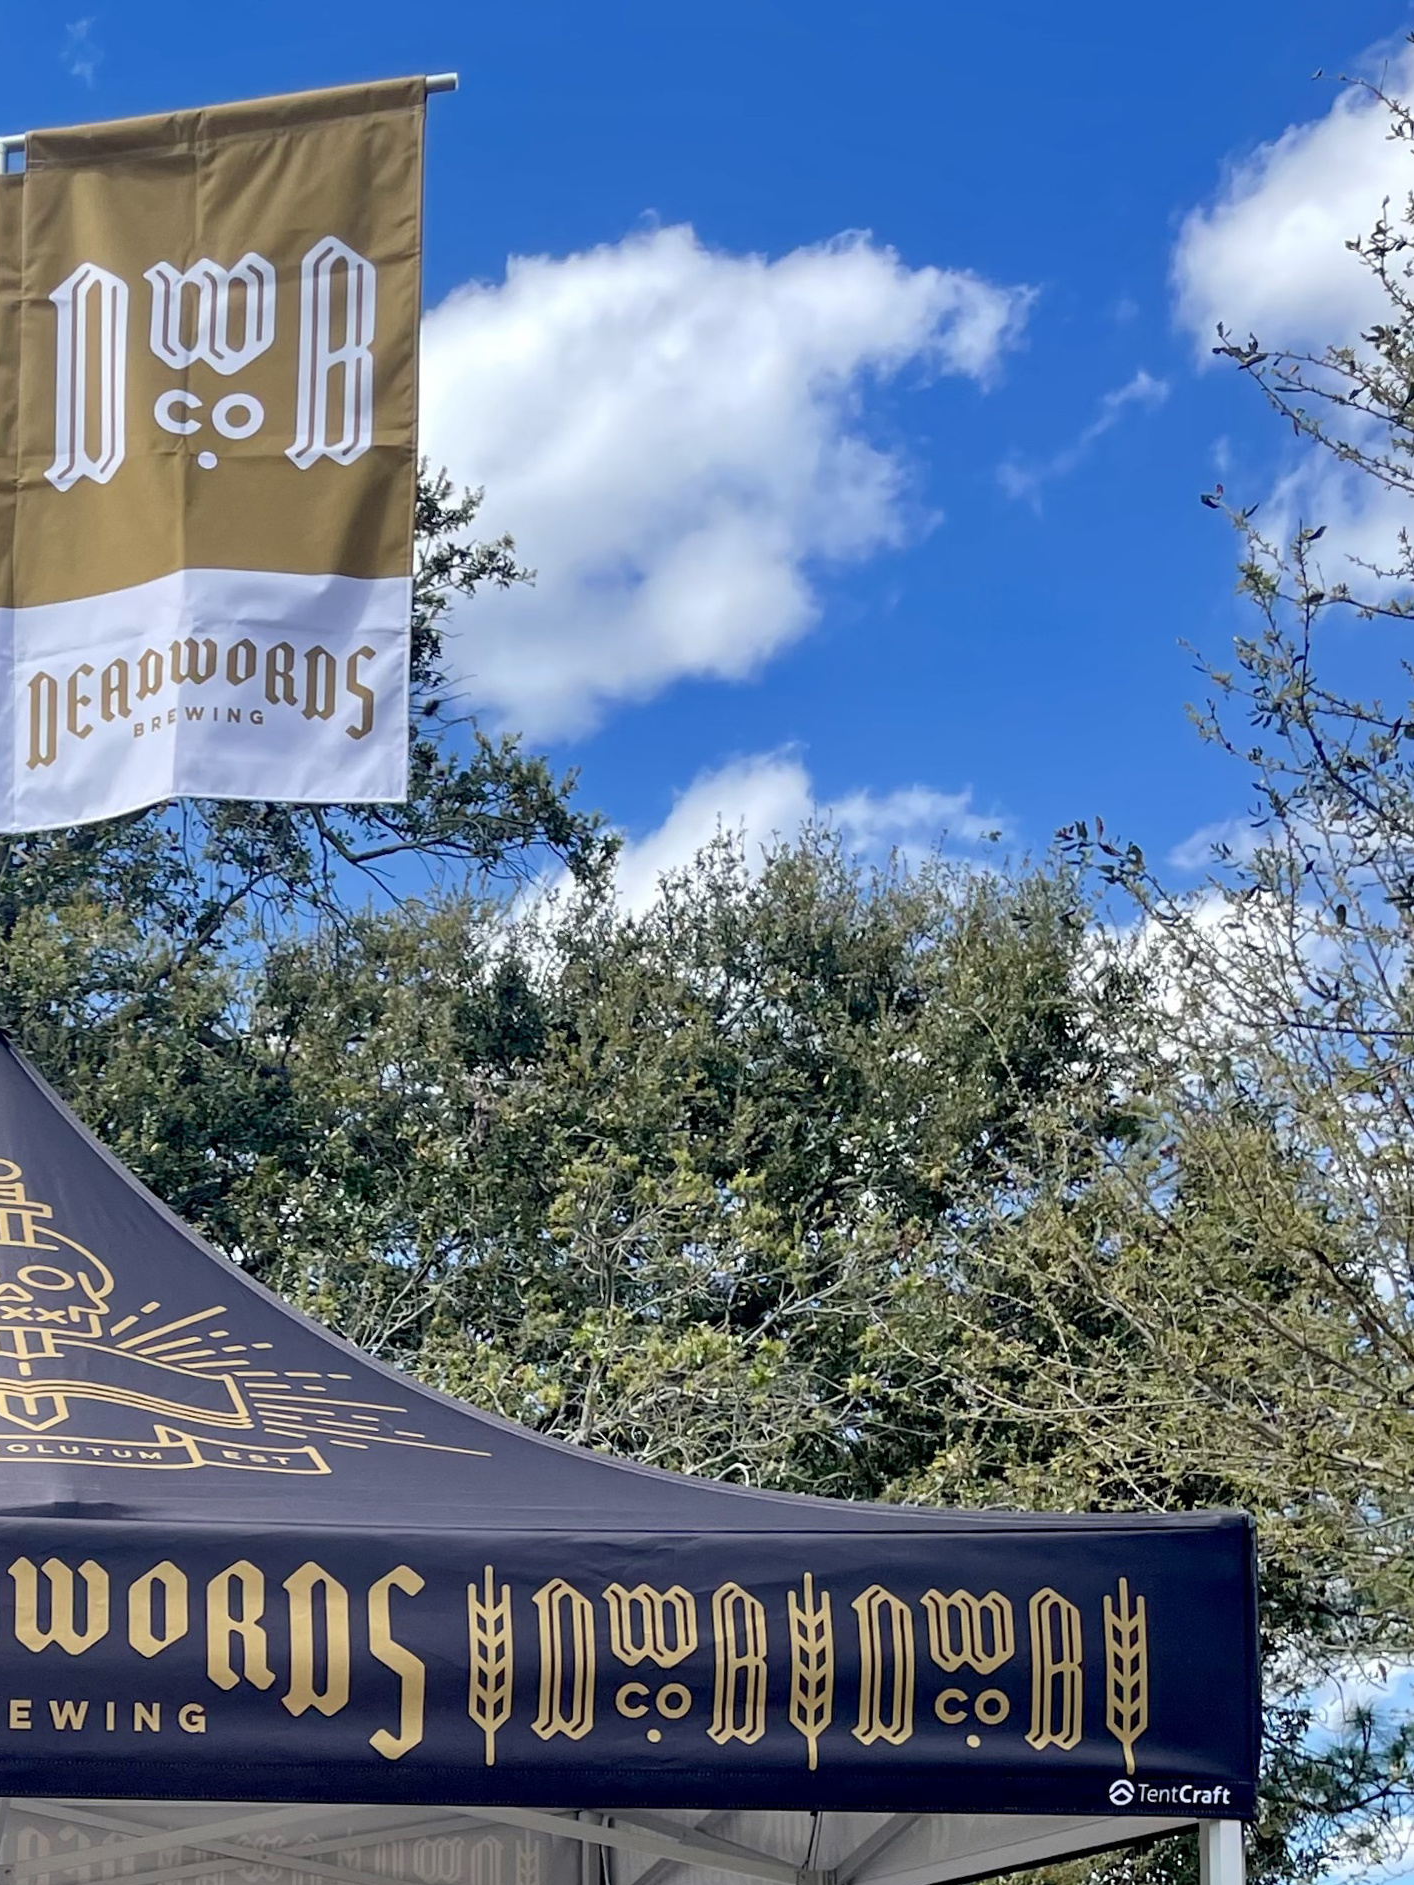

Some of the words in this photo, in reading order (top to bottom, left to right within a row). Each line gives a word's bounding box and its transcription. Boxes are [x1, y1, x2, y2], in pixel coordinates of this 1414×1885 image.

[26, 636, 377, 771] DEADWORDS
[133, 704, 264, 739] BREWING
[222, 1450, 290, 1466] EST
[1138, 1784, 1231, 1805] TentCraft
